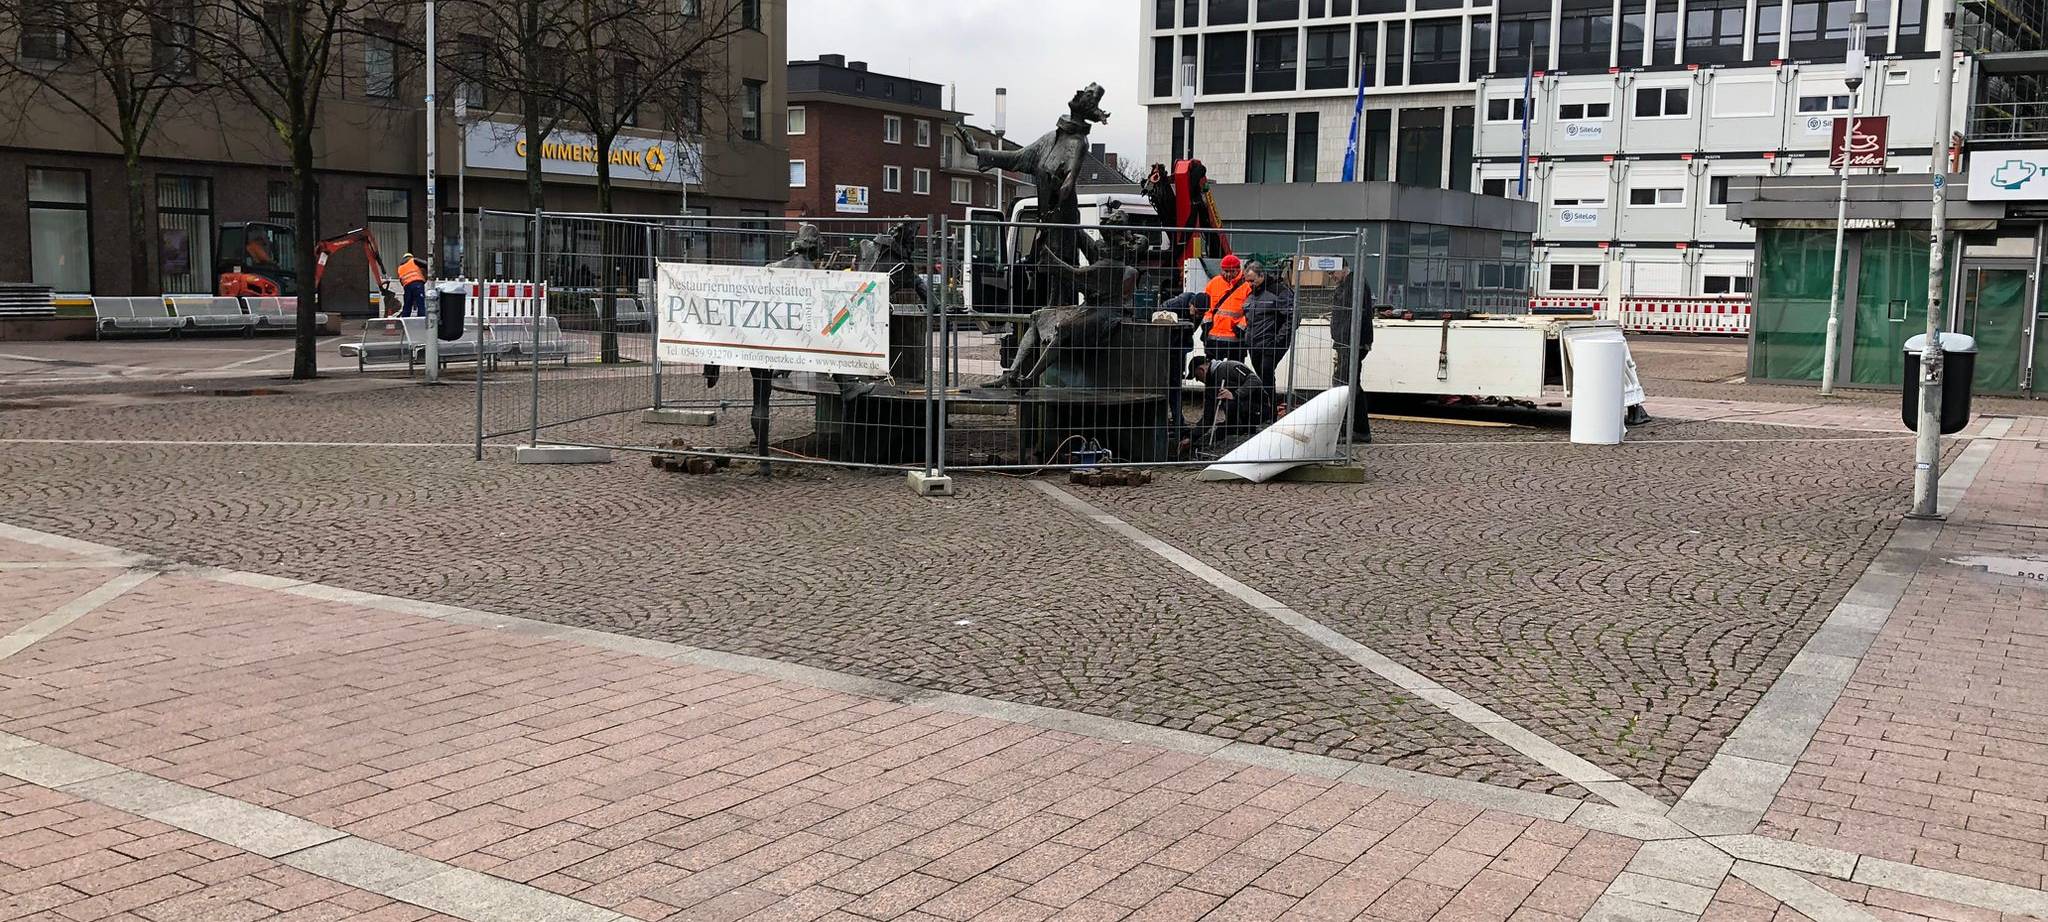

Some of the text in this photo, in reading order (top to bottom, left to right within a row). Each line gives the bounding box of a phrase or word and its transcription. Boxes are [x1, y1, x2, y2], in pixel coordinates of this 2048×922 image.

[1579, 126, 1602, 134] SiteLog
[515, 139, 641, 166] CMMERZANK
[1831, 152, 1883, 165] Zitlos
[1574, 212, 1597, 221] SiteLog
[668, 278, 812, 298] Restaurierungswerkstätten
[666, 295, 804, 331] PAETZKE
[681, 347, 705, 358] 05459
[741, 351, 806, 365] info@paetzke.de
[815, 358, 880, 370] www.paetzke.de
